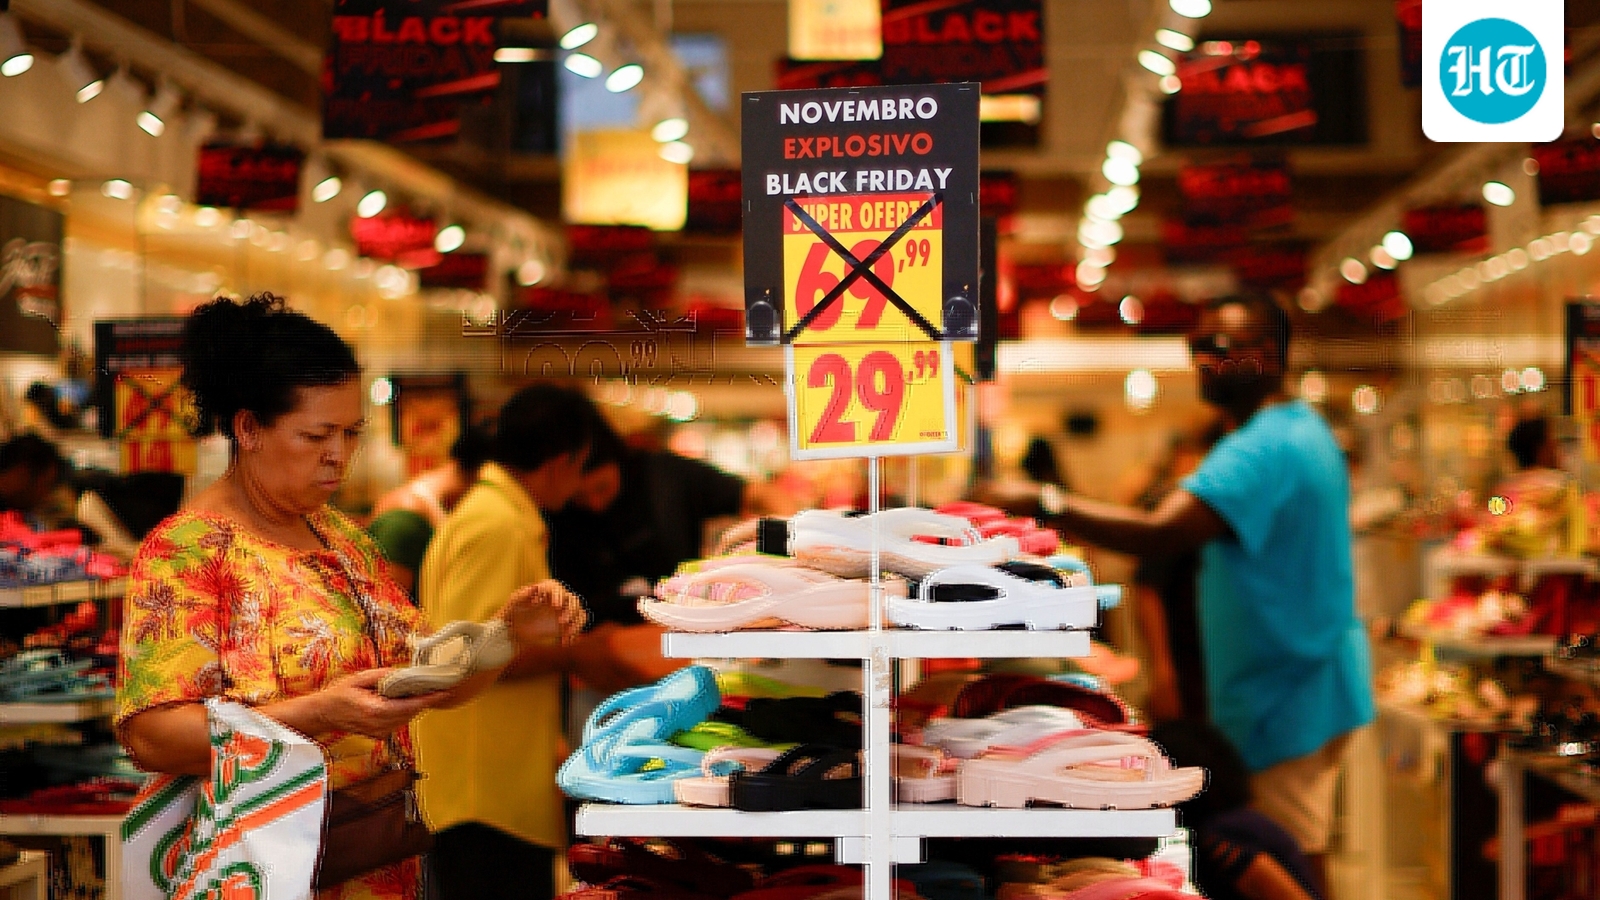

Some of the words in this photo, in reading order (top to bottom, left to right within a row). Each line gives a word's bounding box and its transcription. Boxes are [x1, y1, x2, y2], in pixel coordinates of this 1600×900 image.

[780, 97, 938, 124] NOVEMBRO
[784, 132, 933, 159] EXPLOSIVO
[766, 171, 848, 195] BLACK
[856, 167, 953, 191] FRIDAY
[792, 202, 852, 231] SUPER
[859, 199, 933, 229] OFERTA
